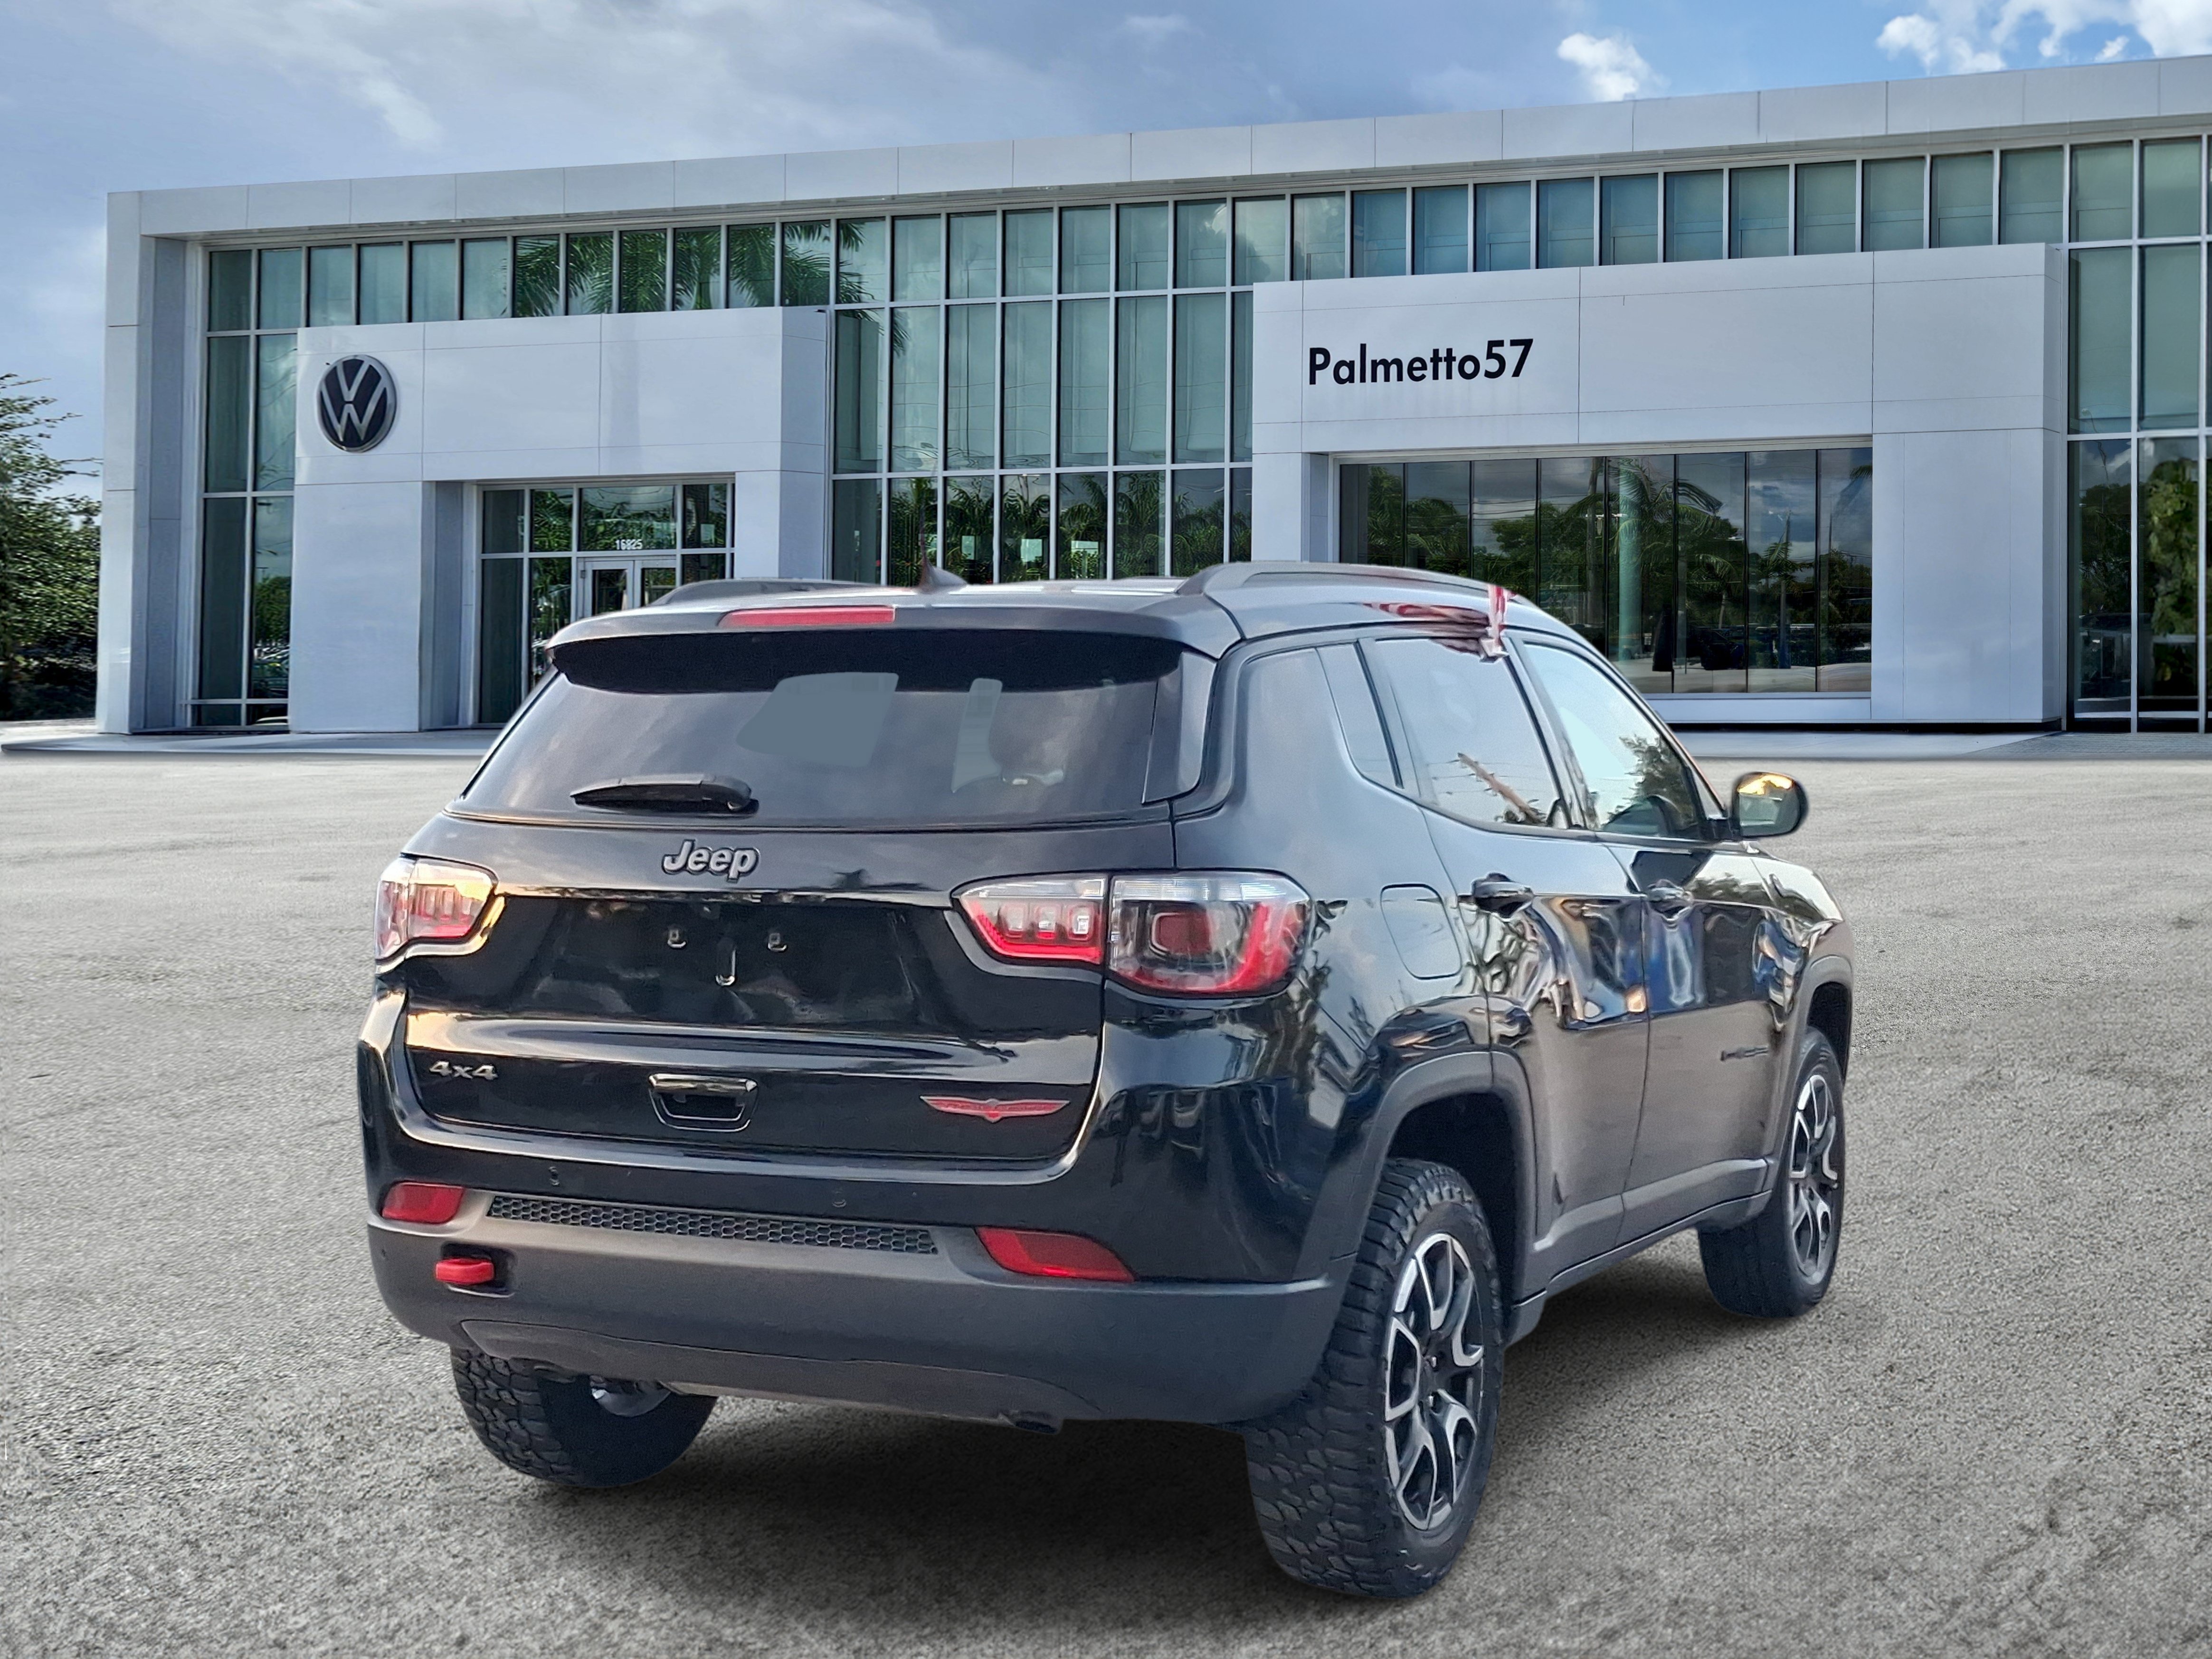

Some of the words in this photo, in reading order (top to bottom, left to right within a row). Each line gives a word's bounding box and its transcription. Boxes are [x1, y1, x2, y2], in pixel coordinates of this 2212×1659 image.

[1309, 338, 1534, 385] Palmetto57
[318, 356, 390, 446] VW
[662, 839, 759, 882] Jeep
[429, 1061, 498, 1081] 4x4
